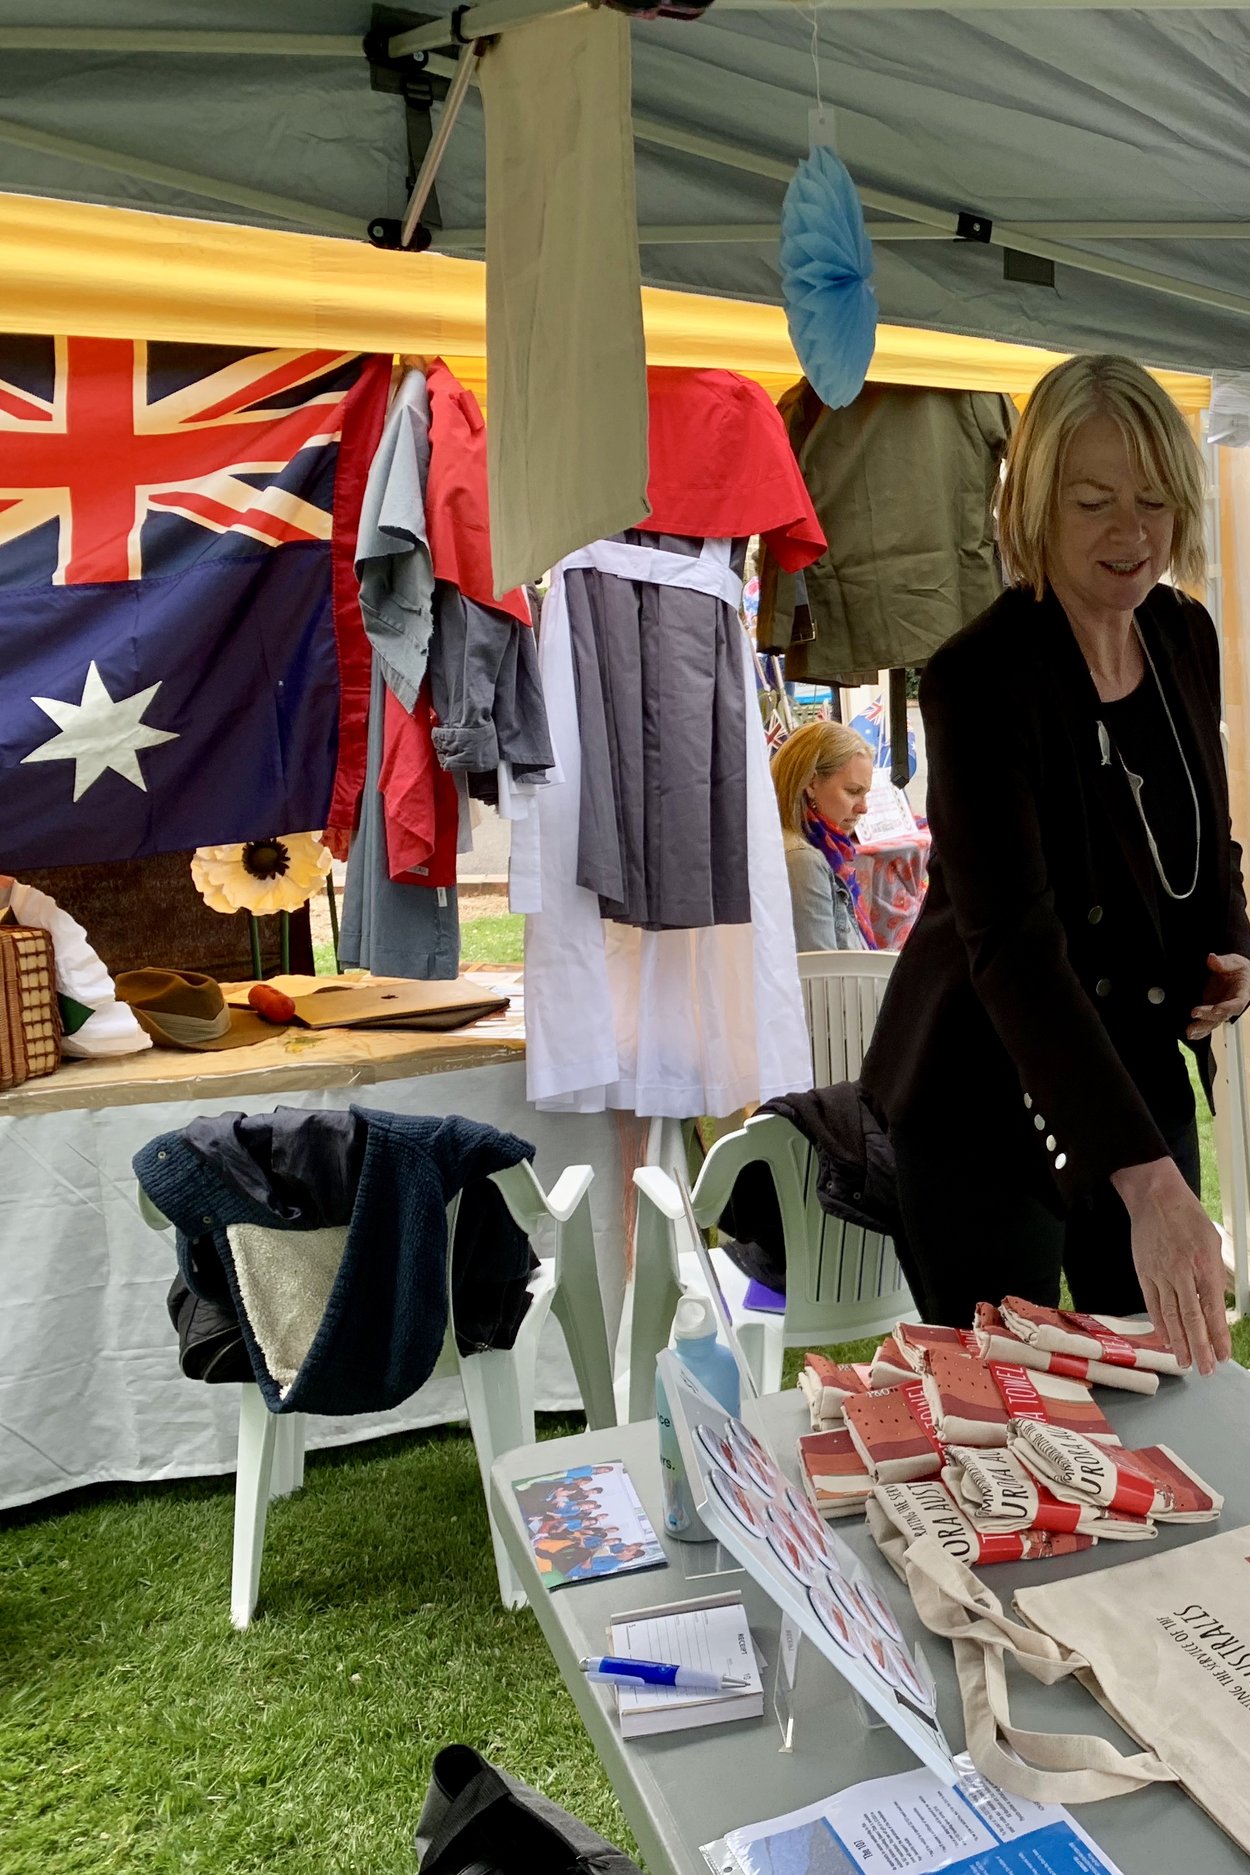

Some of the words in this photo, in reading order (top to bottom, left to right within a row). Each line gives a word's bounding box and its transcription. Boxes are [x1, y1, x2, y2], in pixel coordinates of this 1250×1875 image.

[994, 1365, 1038, 1409] TOWEL
[737, 1632, 748, 1655] RECEIPT
[1170, 1631, 1188, 1642] OF
[1182, 1642, 1220, 1670] SERVICE
[1213, 1670, 1233, 1686] THE
[860, 1848, 873, 1859] The
